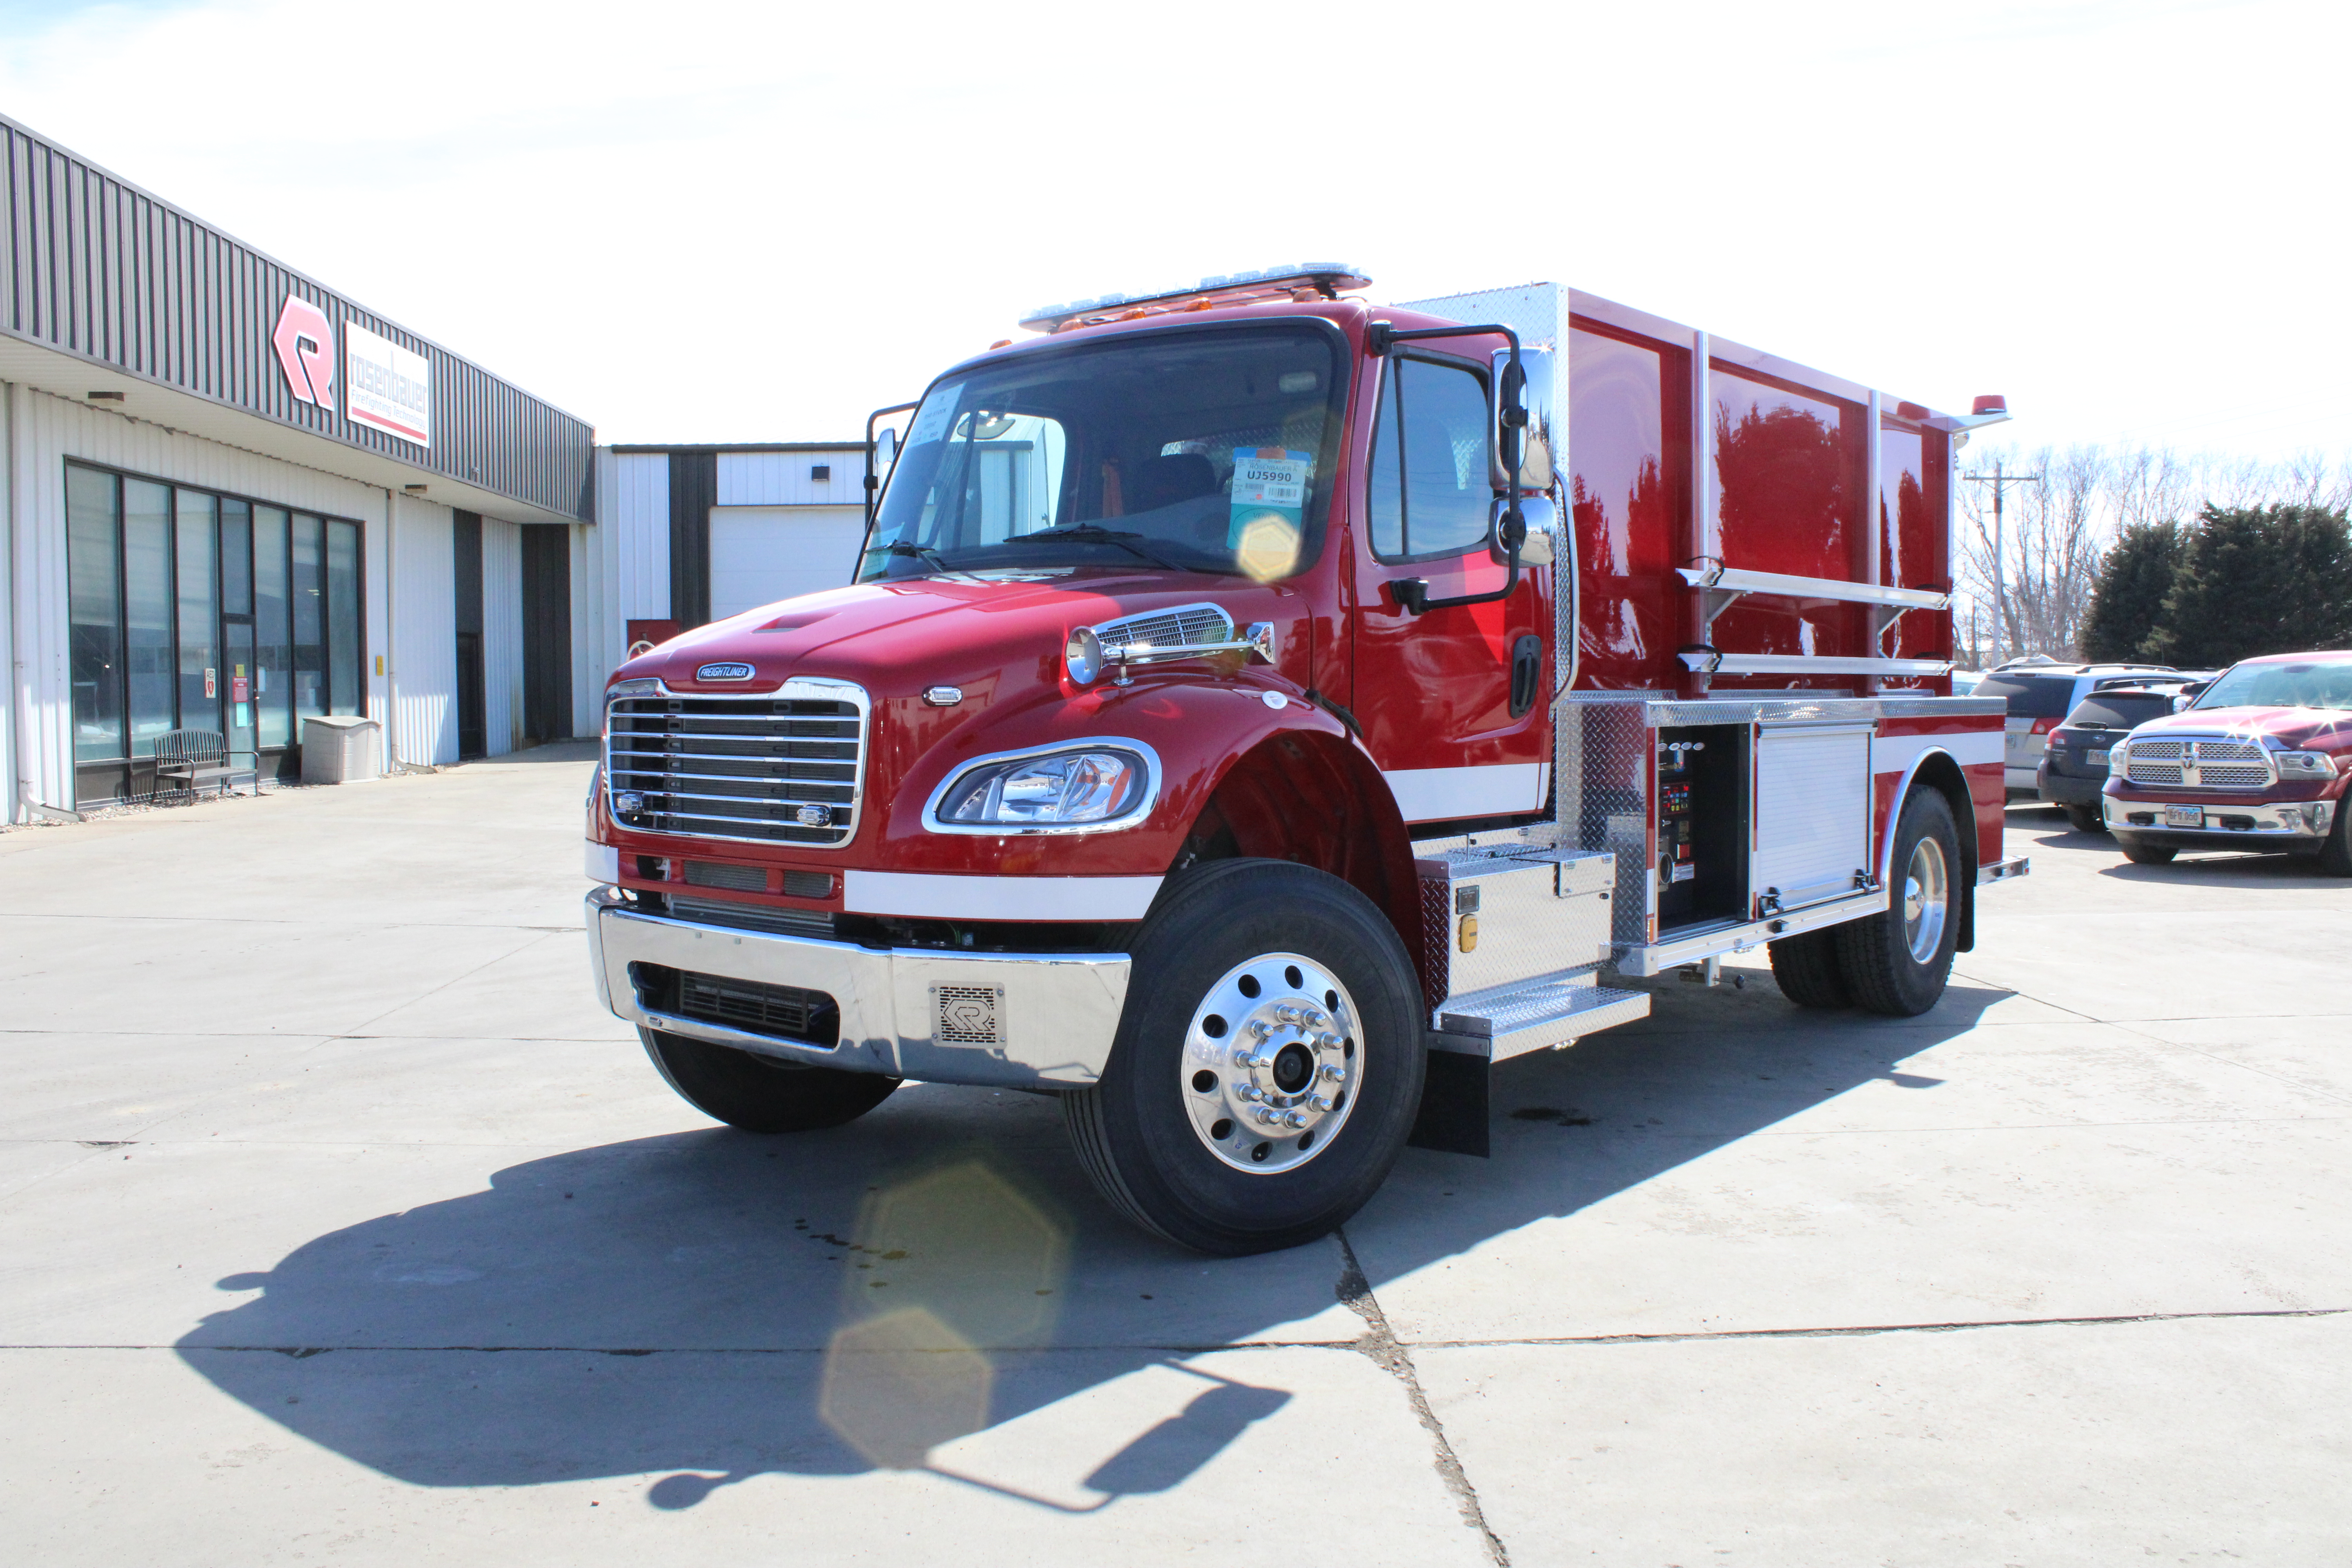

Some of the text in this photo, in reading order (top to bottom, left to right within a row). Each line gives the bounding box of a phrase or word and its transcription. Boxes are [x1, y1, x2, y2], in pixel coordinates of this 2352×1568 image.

[350, 350, 427, 414] rosenbauer
[351, 389, 426, 430] Firefighting Technology
[1247, 470, 1292, 482] UJ5990
[207, 670, 215, 678] AED
[700, 666, 748, 677] FREIGHTLINER
